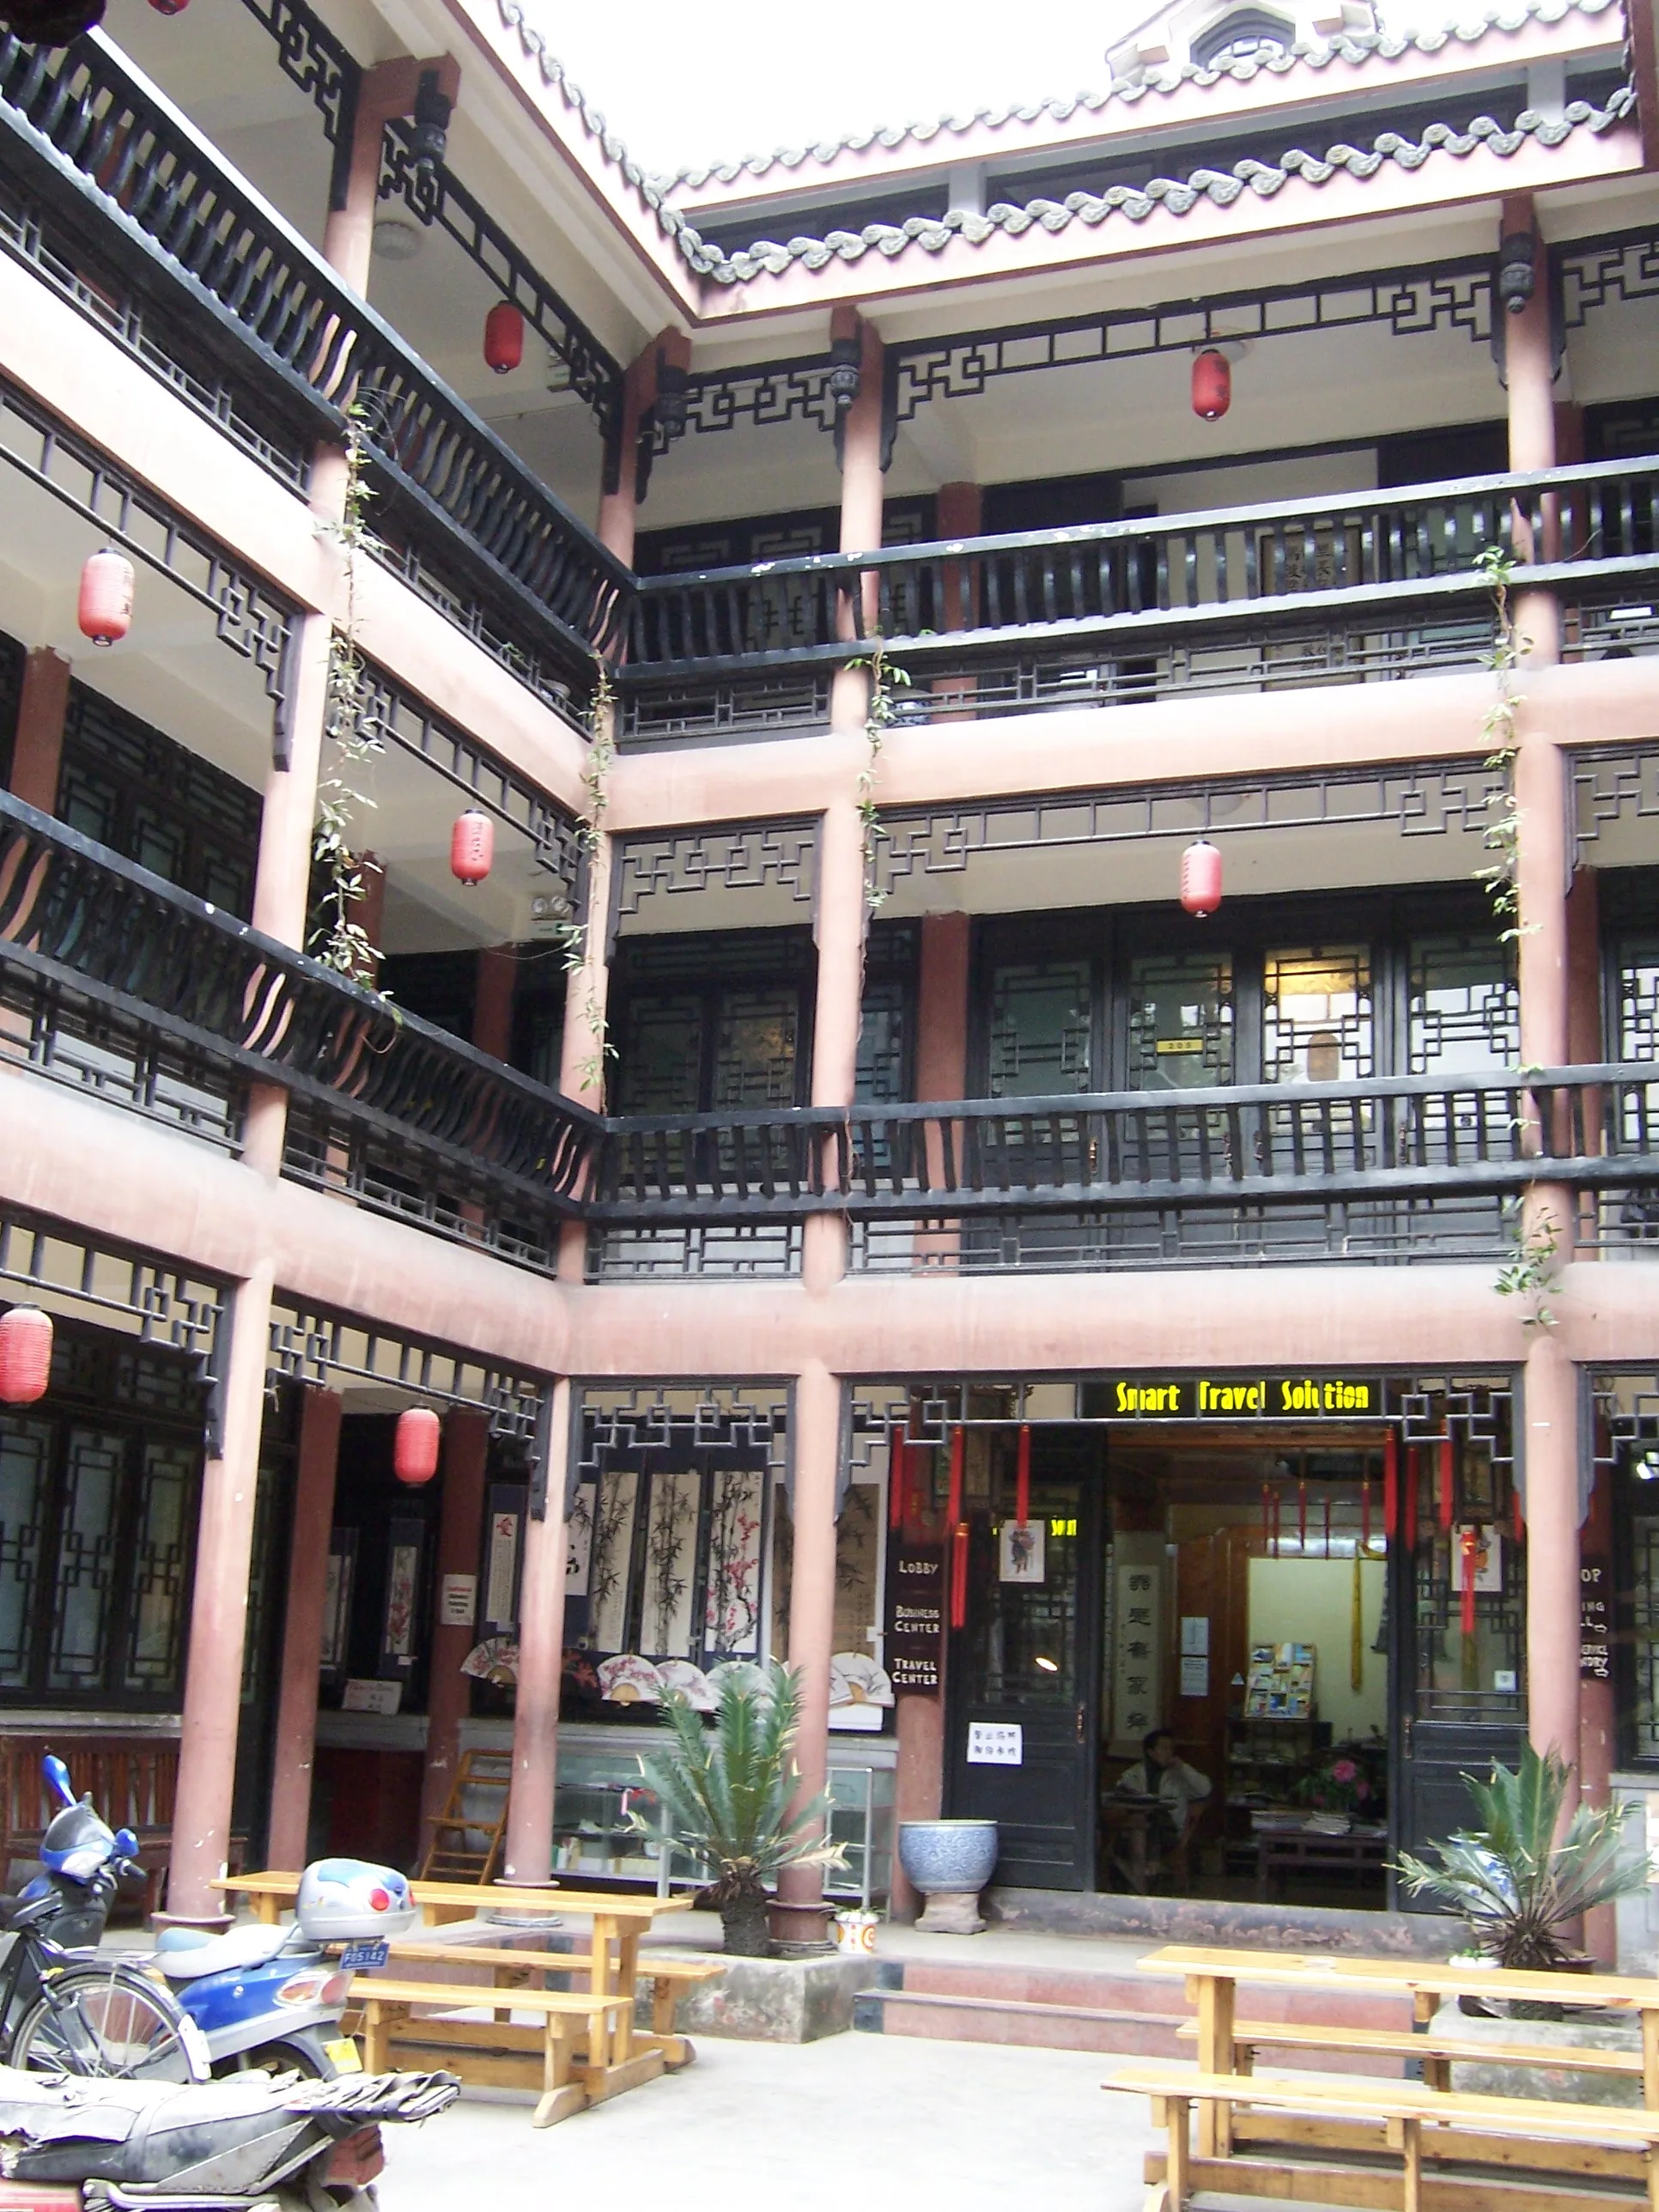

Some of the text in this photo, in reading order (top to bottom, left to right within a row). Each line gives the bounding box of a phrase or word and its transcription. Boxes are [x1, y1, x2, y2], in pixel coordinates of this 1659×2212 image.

[1116, 1380, 1370, 1413] Smart Travel Solution
[898, 1560, 939, 1576] LOBBY
[895, 1605, 940, 1619] BUSINESS
[894, 1620, 940, 1634] CENTER
[894, 1658, 937, 1671] TRAVEL
[891, 1671, 938, 1686] CENTER
